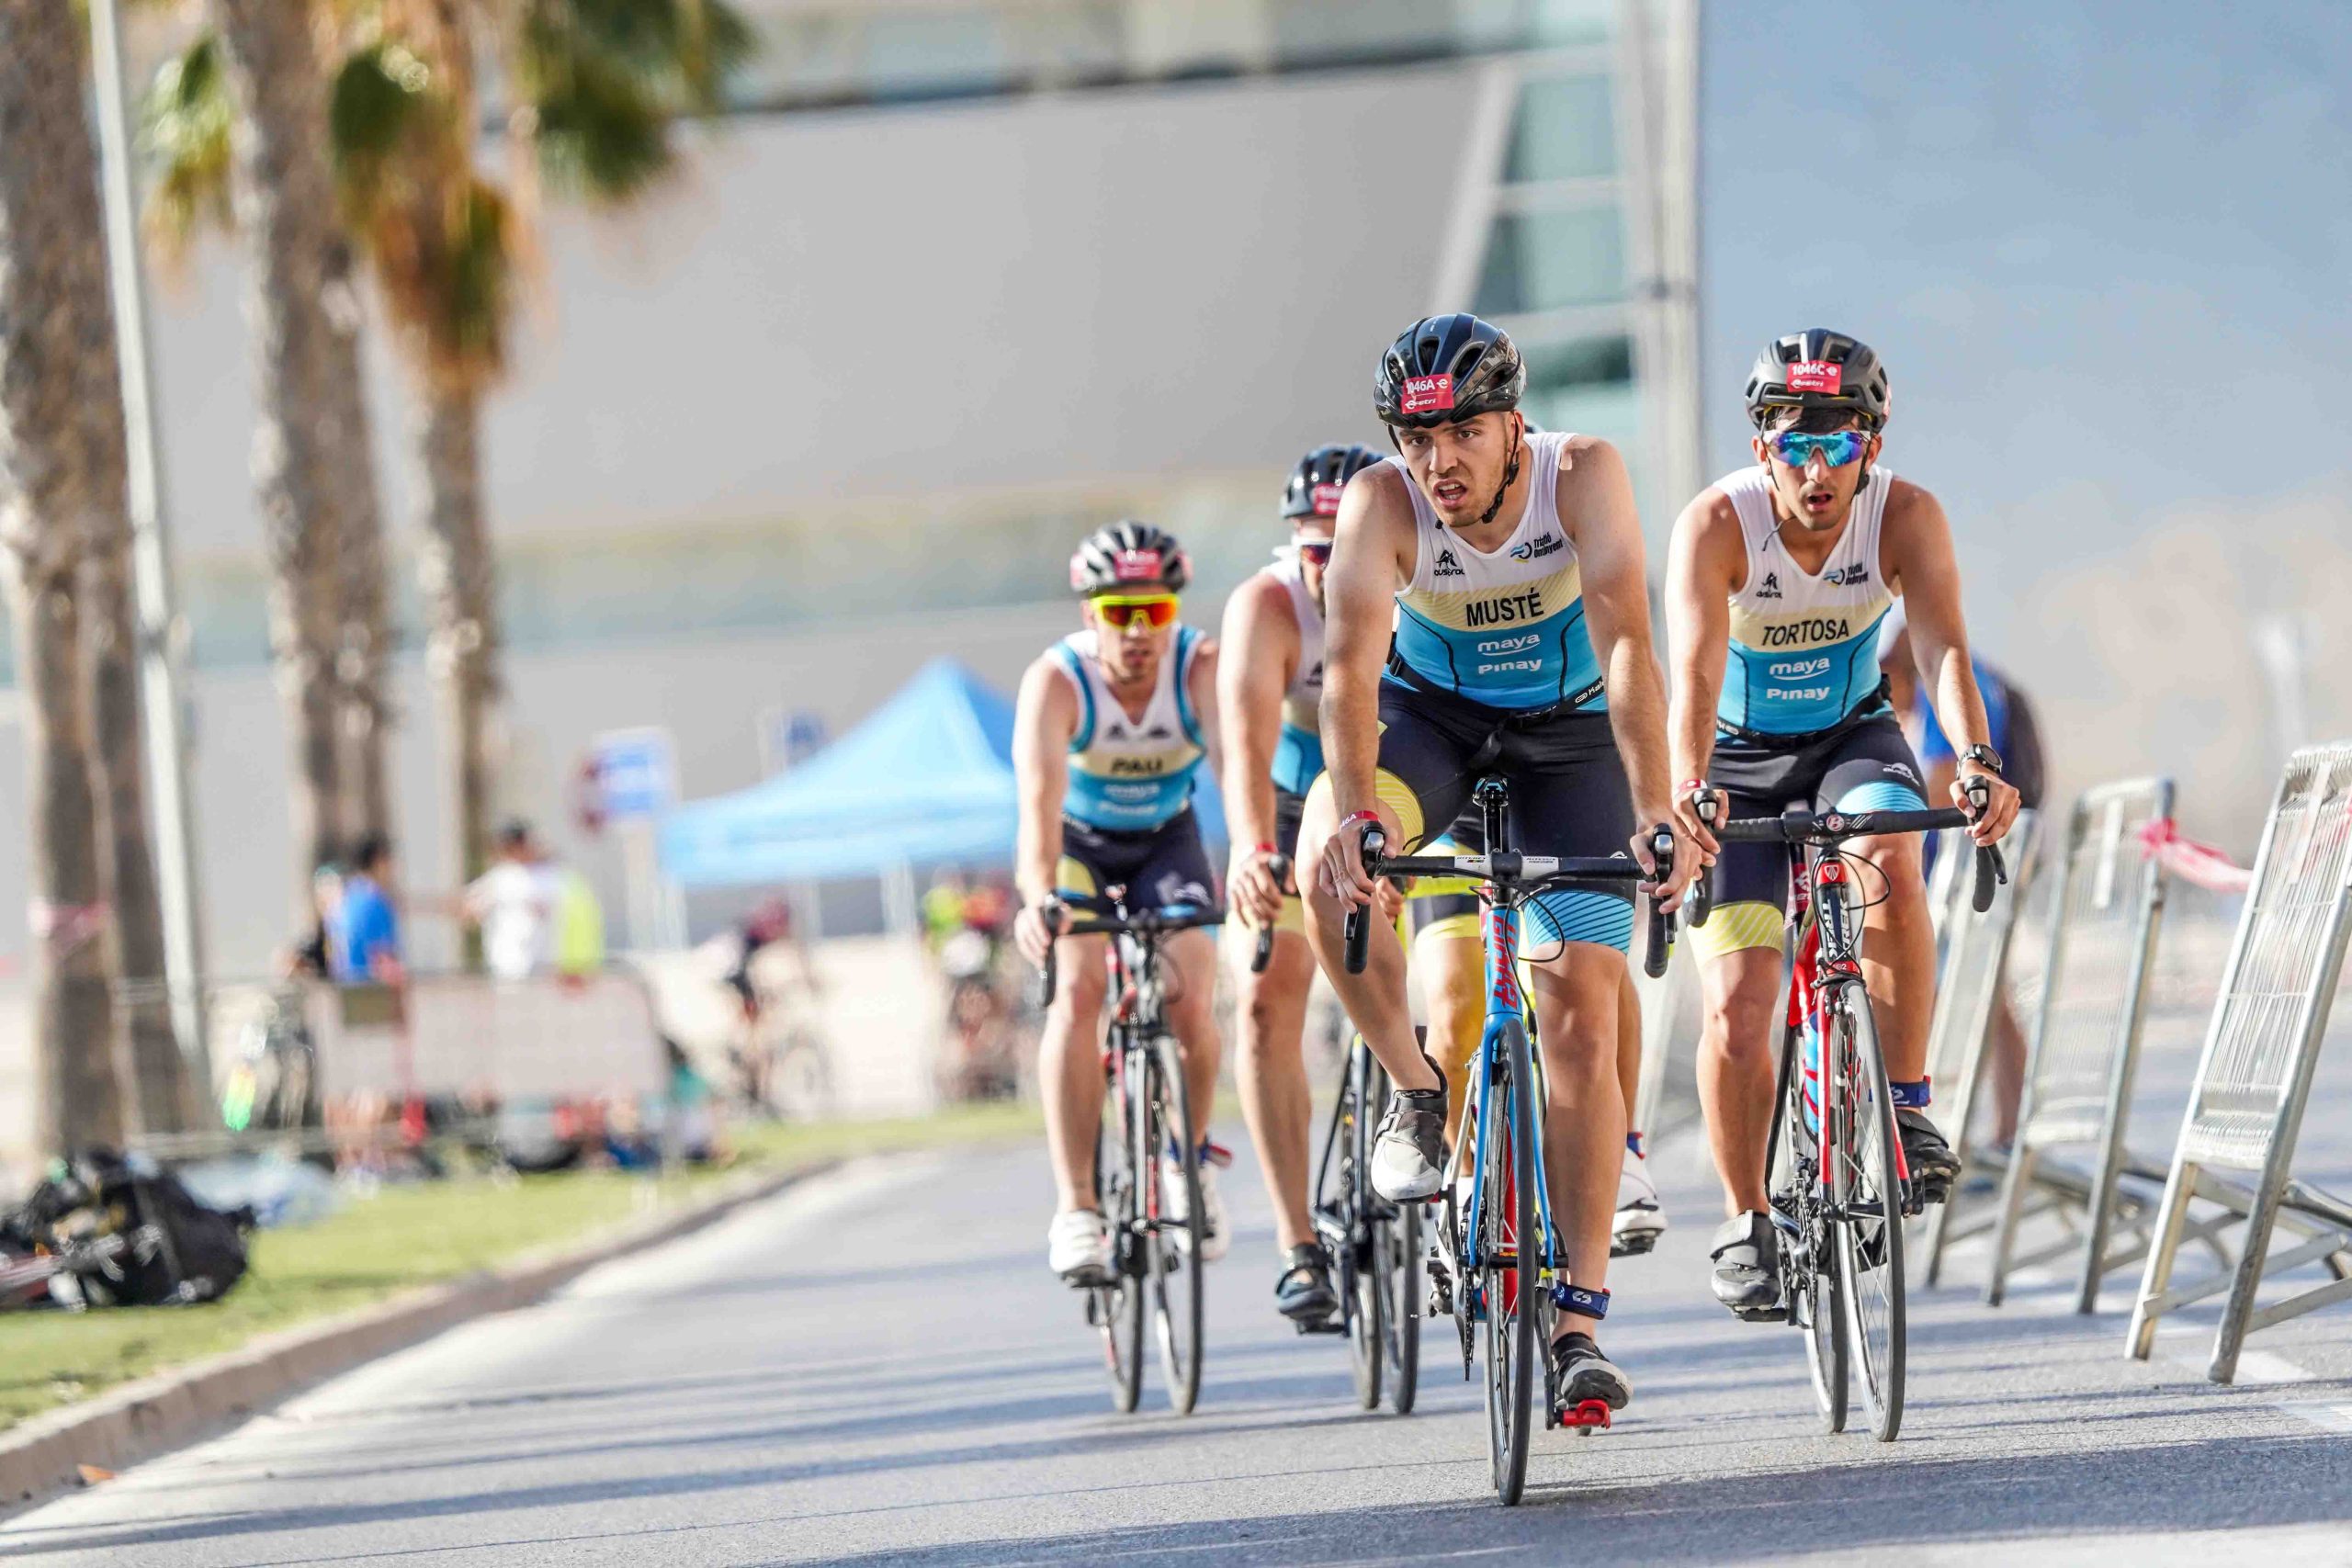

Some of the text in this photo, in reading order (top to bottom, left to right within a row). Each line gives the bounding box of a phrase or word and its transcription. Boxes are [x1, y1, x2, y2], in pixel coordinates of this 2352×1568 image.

[1465, 587, 1544, 627] MUSTÉ
[1476, 634, 1542, 653] maya
[1761, 618, 1849, 647] TORTOSA
[1768, 657, 1831, 676] maya
[1822, 897, 1838, 959] TREK
